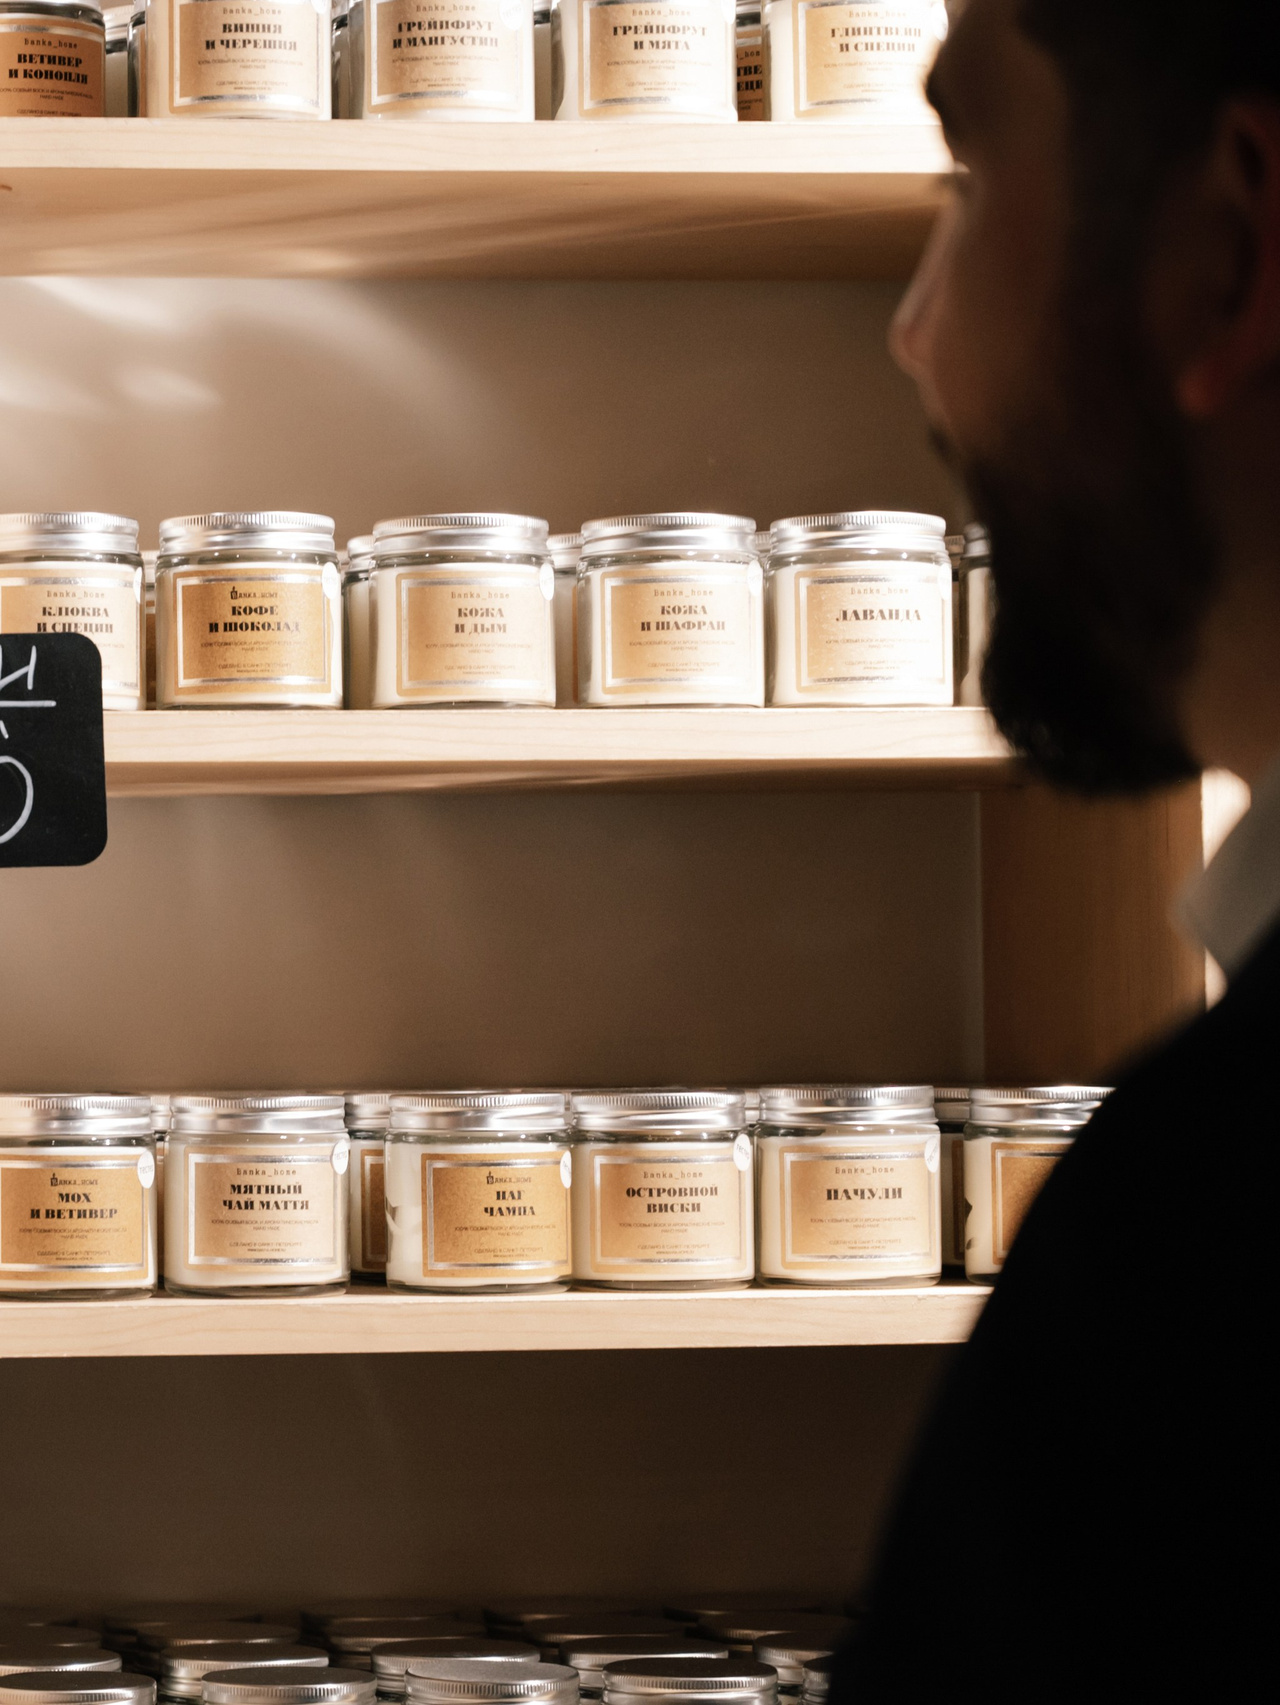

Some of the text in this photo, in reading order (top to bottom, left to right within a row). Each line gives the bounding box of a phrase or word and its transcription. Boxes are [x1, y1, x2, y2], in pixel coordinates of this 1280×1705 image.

[222, 23, 282, 34] ВИШНЯ
[397, 17, 494, 33] ГРЕЙПФРУТ
[612, 22, 708, 36] ГРЕЙПФРУТ
[205, 39, 297, 51] И ЧЕРЕШНЯ
[392, 35, 498, 49] И МАНГУСТИН
[633, 40, 690, 50] И МЯТА
[839, 41, 915, 53] И СПЕЦИИ
[17, 53, 83, 68] ВЕТИВЕР
[8, 68, 88, 85] И КОНОПЛЯ
[42, 606, 109, 617] КЛЮКВА
[231, 605, 279, 616] КОФЕ
[457, 607, 504, 618] КОЖА
[660, 605, 708, 615] КОЖА
[835, 609, 921, 622] ЛАВАНДА
[37, 622, 113, 635] И СПЕЦИИ
[208, 621, 300, 633] И ШОКОЛАД
[454, 623, 507, 635] И ДЫМ
[640, 621, 726, 632] И ШАФРАН
[230, 1182, 302, 1195] МЯТНЫЙ
[626, 1184, 718, 1198] ОСТРОВНОЙ
[826, 1187, 903, 1200] ПАЧУЛИ
[58, 1193, 92, 1204] МОХ
[222, 1198, 255, 1211] ЧАЙ
[30, 1208, 118, 1220] И ВЕТИВЕР
[483, 1206, 536, 1217] ЧАМПА
[647, 1203, 701, 1213] ВИСКИ
